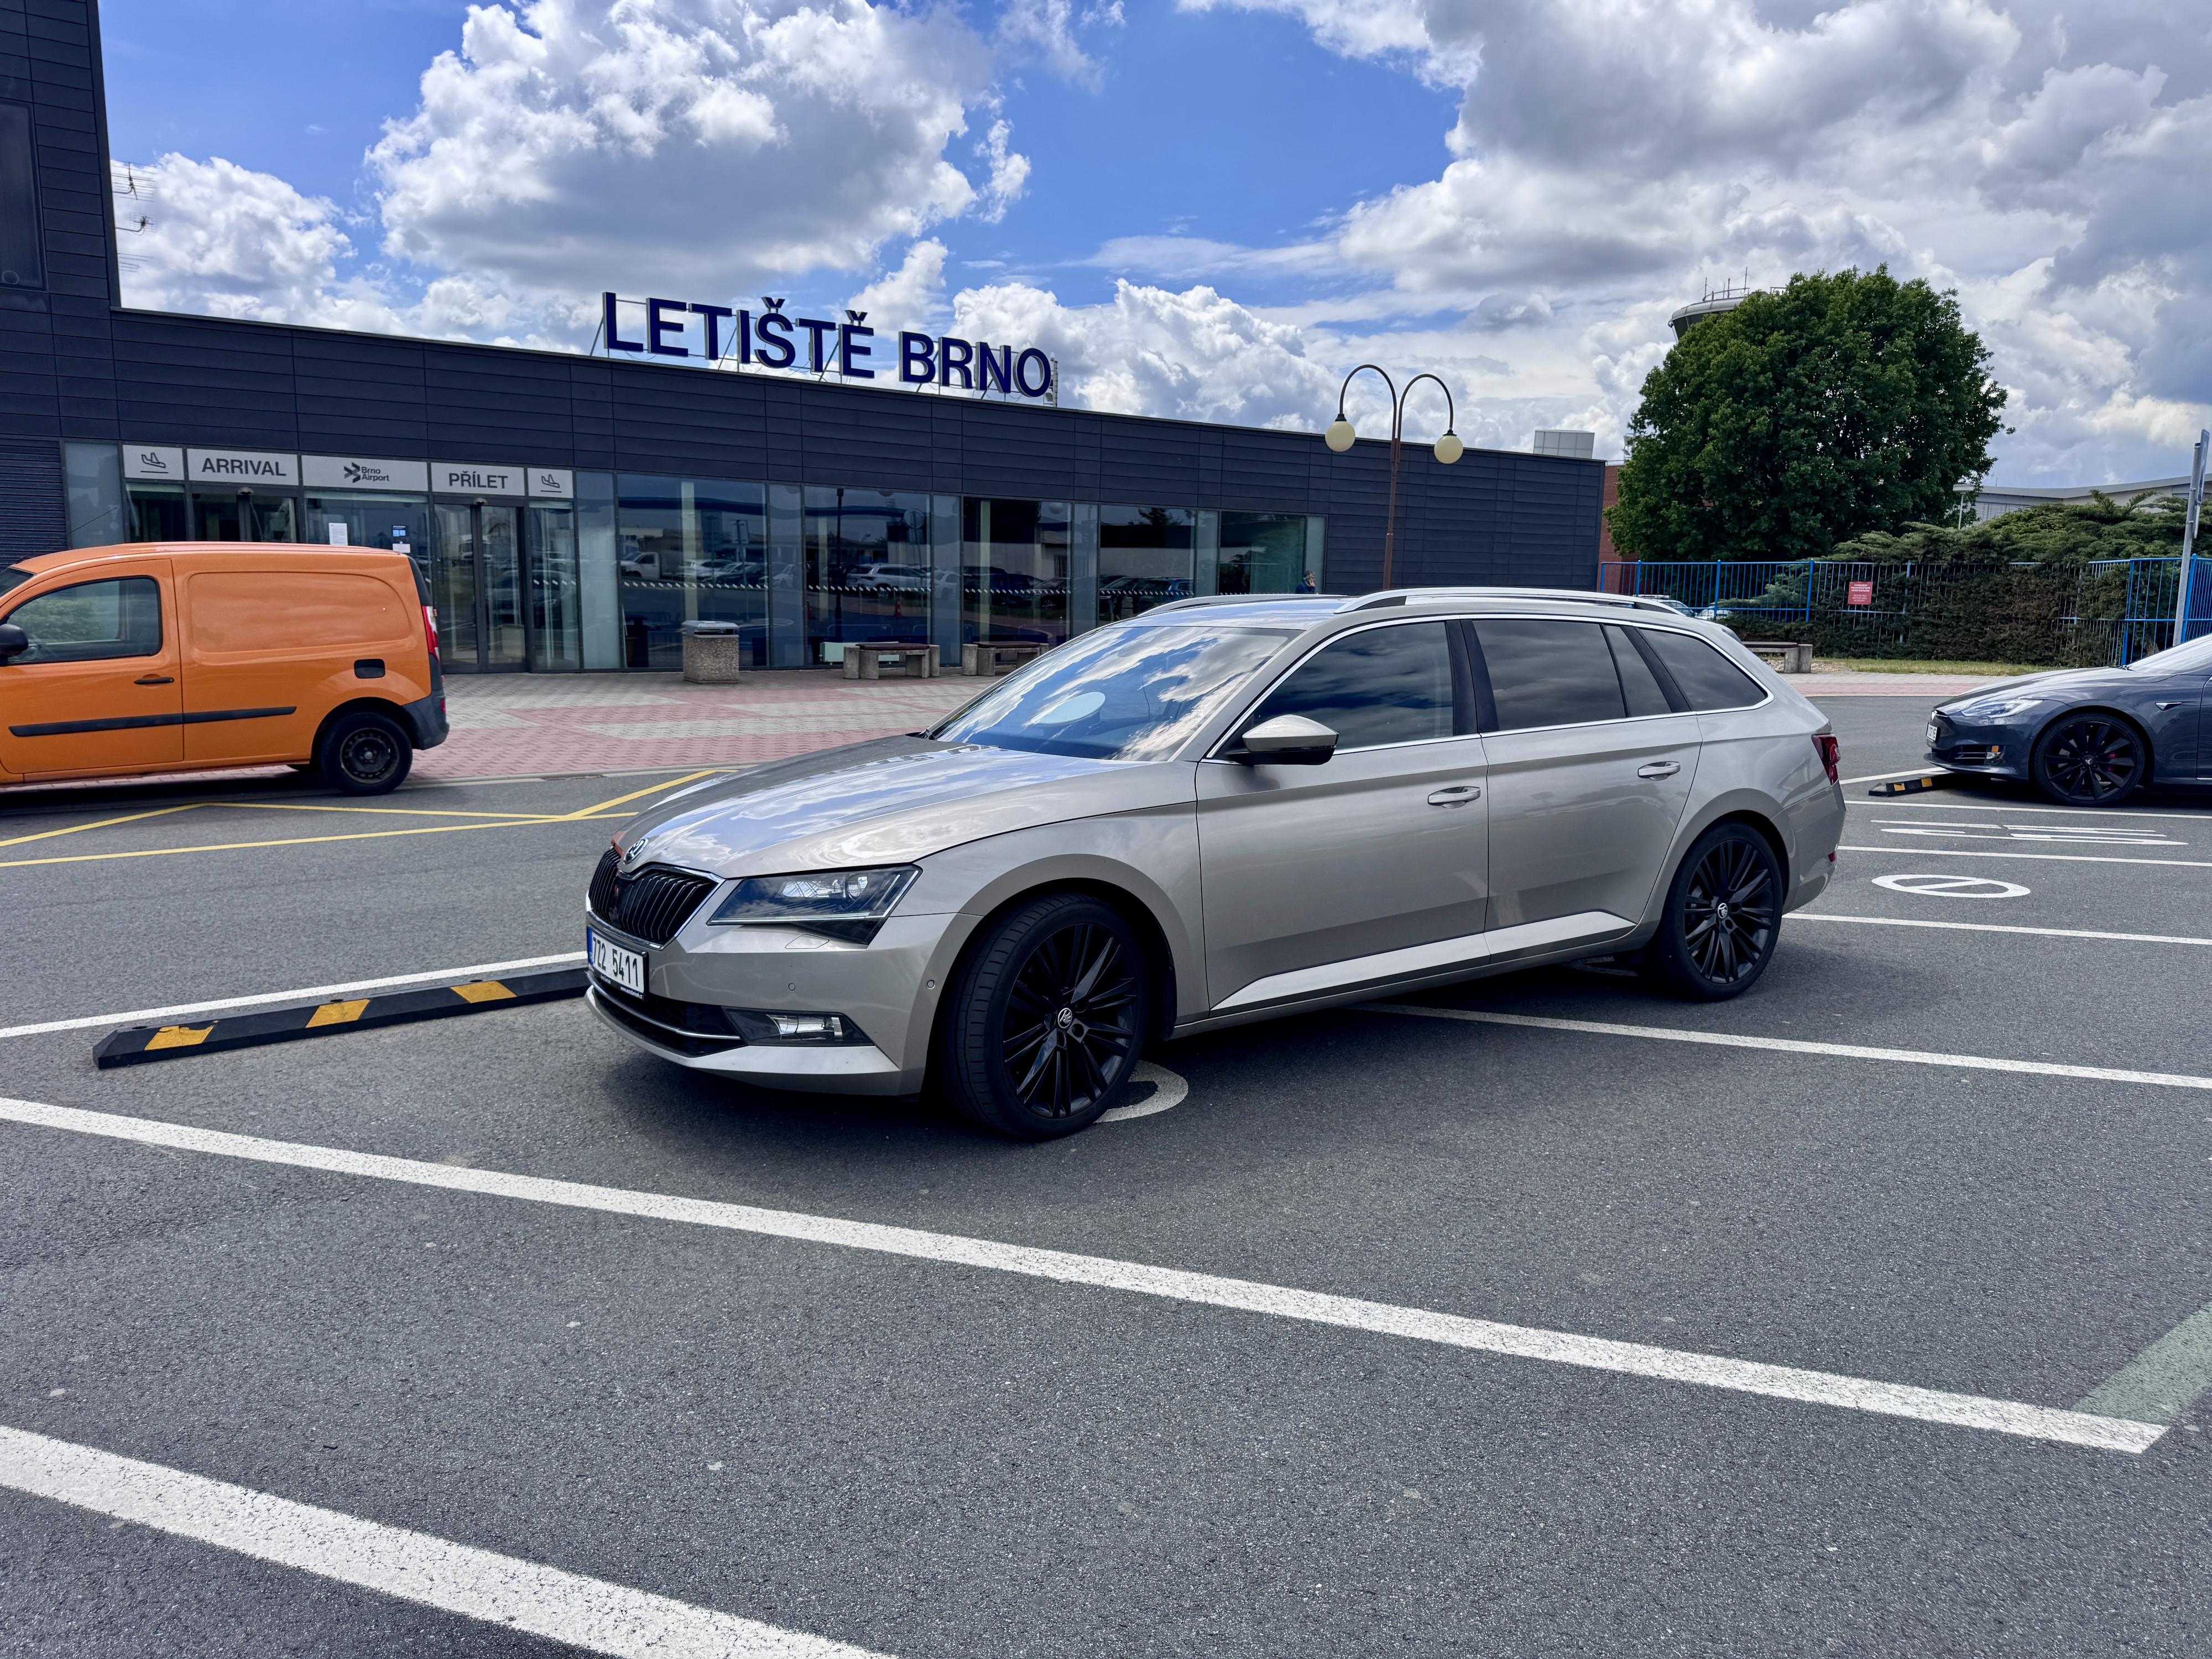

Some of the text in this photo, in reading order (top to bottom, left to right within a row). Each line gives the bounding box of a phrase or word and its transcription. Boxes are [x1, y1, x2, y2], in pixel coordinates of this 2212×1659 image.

[602, 291, 1051, 398] LETIŠTĚ BRNO
[201, 457, 286, 477] ARRIVAL
[362, 473, 390, 482] Airport
[448, 471, 508, 489] PŘÍLET
[593, 936, 638, 987] 7Z2 5411
